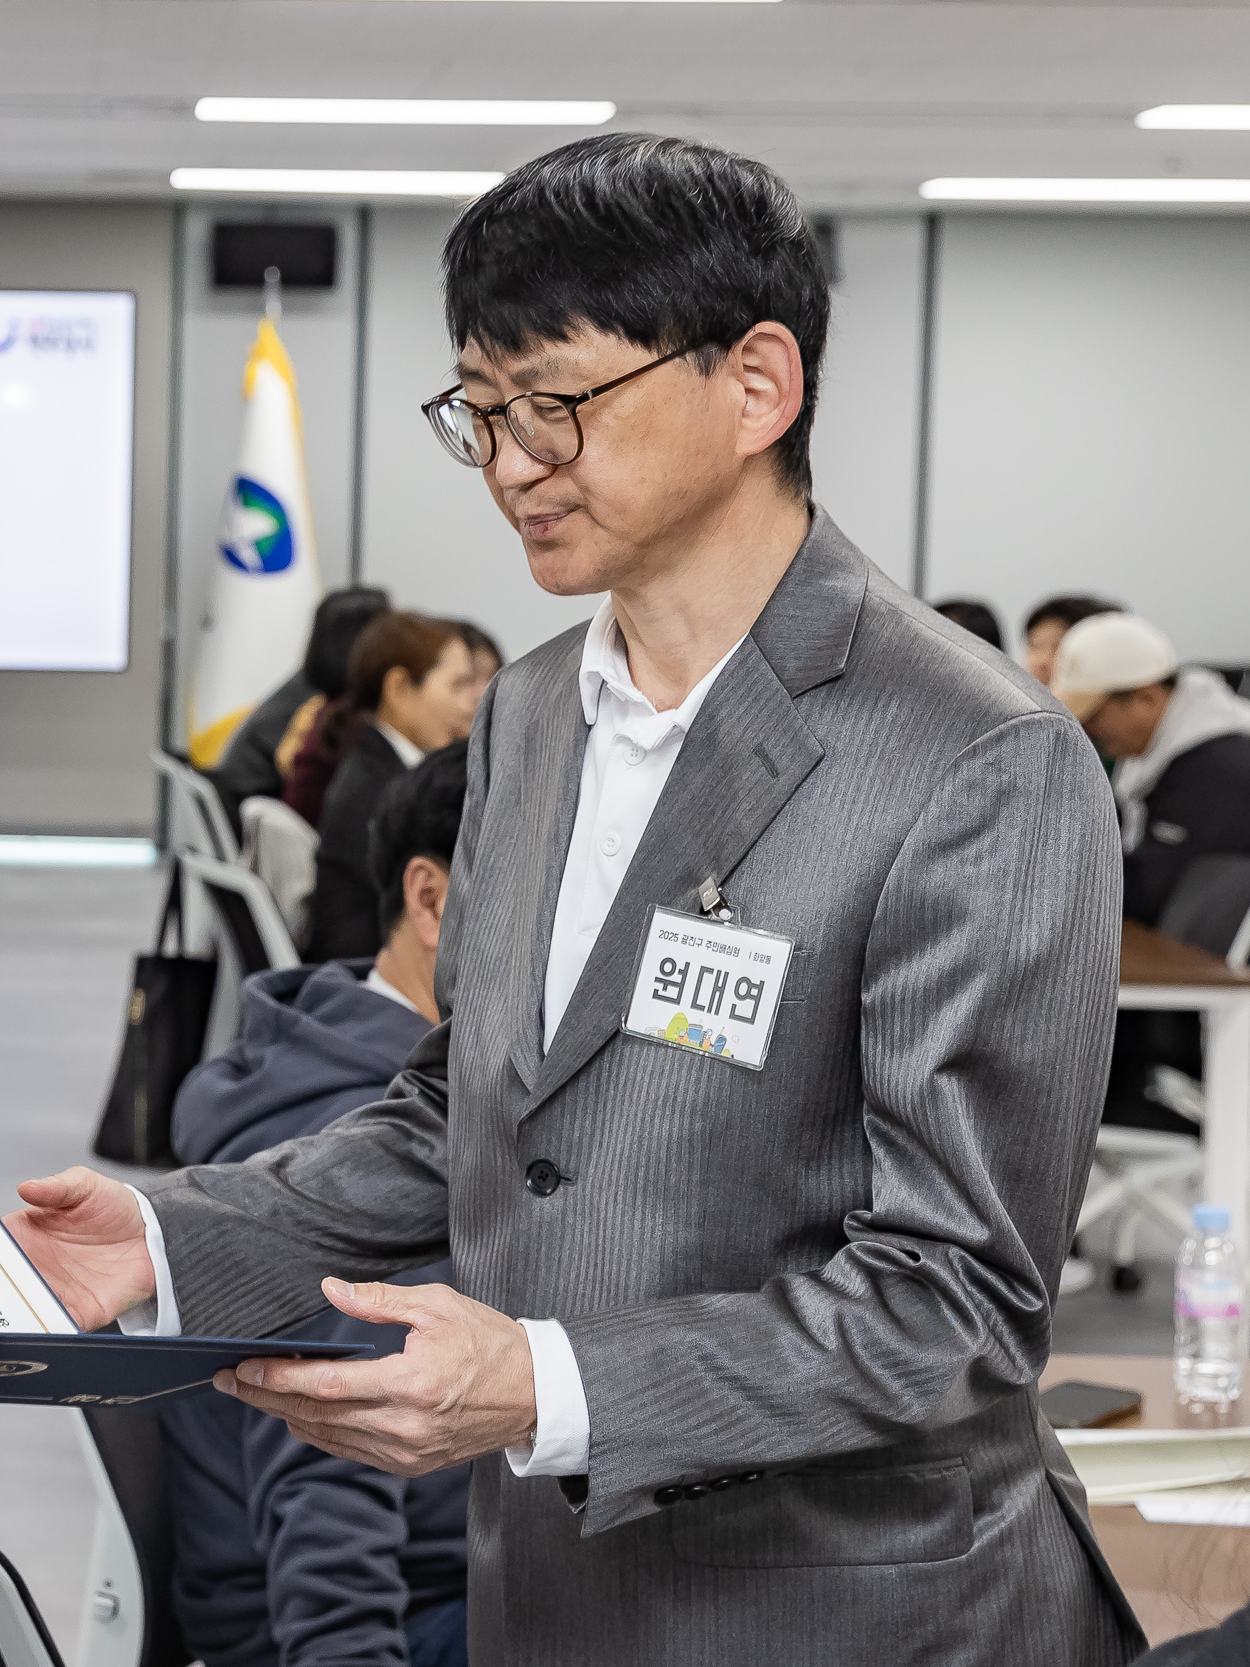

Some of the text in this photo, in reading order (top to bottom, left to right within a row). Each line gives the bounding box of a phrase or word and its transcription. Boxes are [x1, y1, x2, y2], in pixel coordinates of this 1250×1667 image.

[658, 929, 679, 943] 2025
[681, 934, 704, 948] 광진구
[705, 940, 741, 958] 주민배심원
[651, 957, 766, 1026] 원대연
